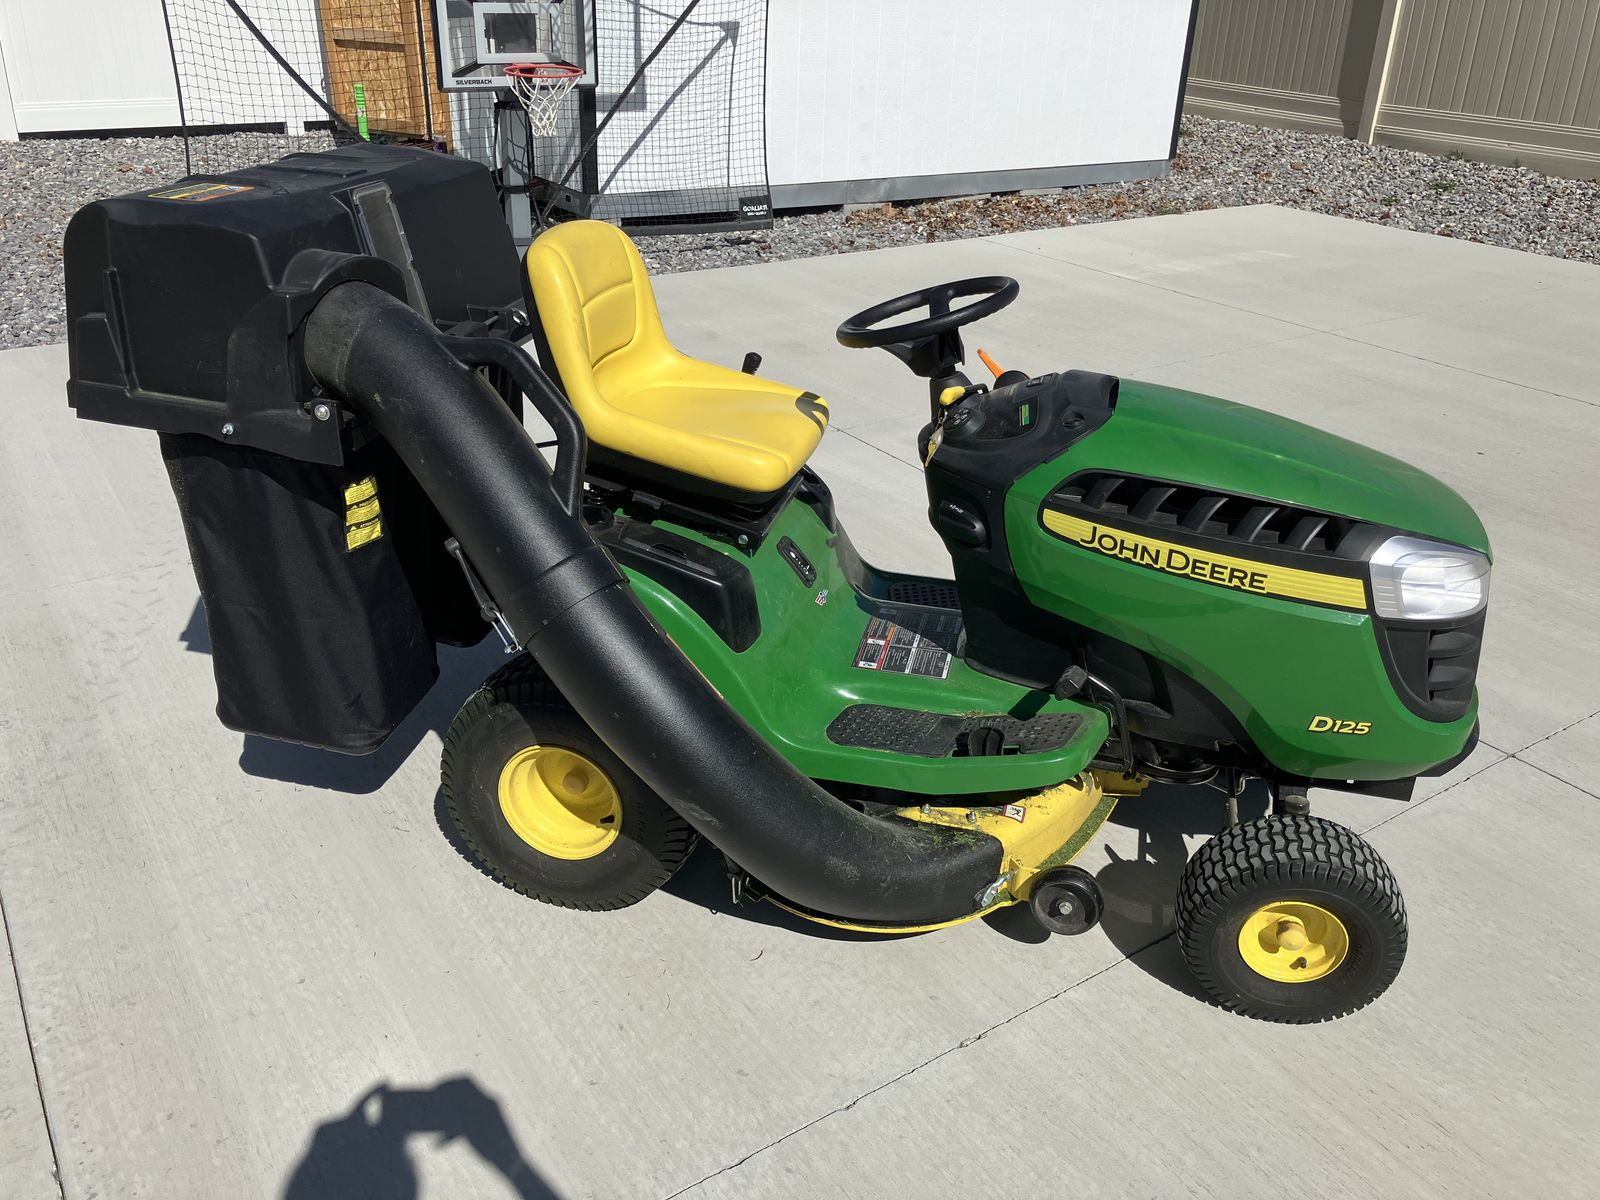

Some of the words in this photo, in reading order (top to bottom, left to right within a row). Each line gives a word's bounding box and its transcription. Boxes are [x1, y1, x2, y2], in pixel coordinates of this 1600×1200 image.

[1080, 526, 1160, 566] JOHN
[1166, 548, 1268, 591] DEERE
[1307, 715, 1372, 735] D125
